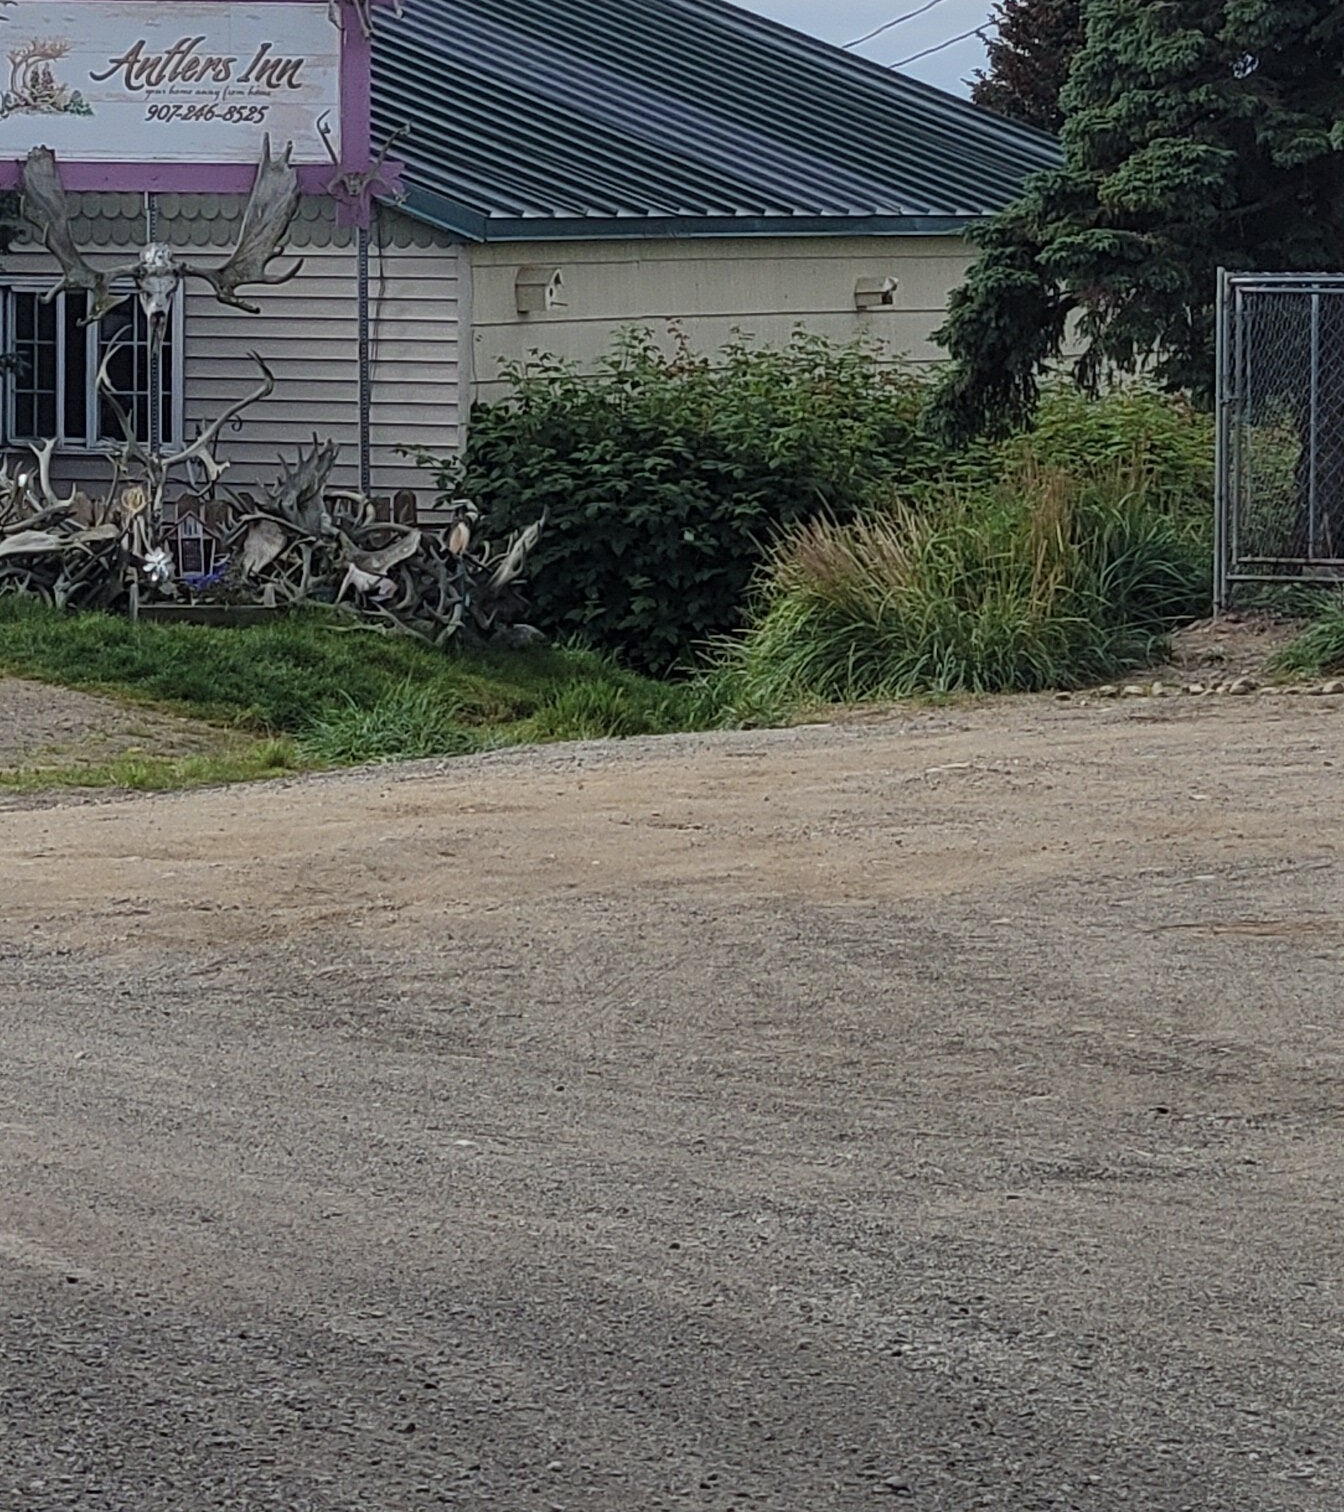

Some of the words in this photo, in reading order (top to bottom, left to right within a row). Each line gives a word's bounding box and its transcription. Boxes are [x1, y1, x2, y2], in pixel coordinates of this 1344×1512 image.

[89, 36, 237, 91] Antlers
[236, 42, 304, 89] Inn
[144, 103, 270, 124] 907-246-8525
